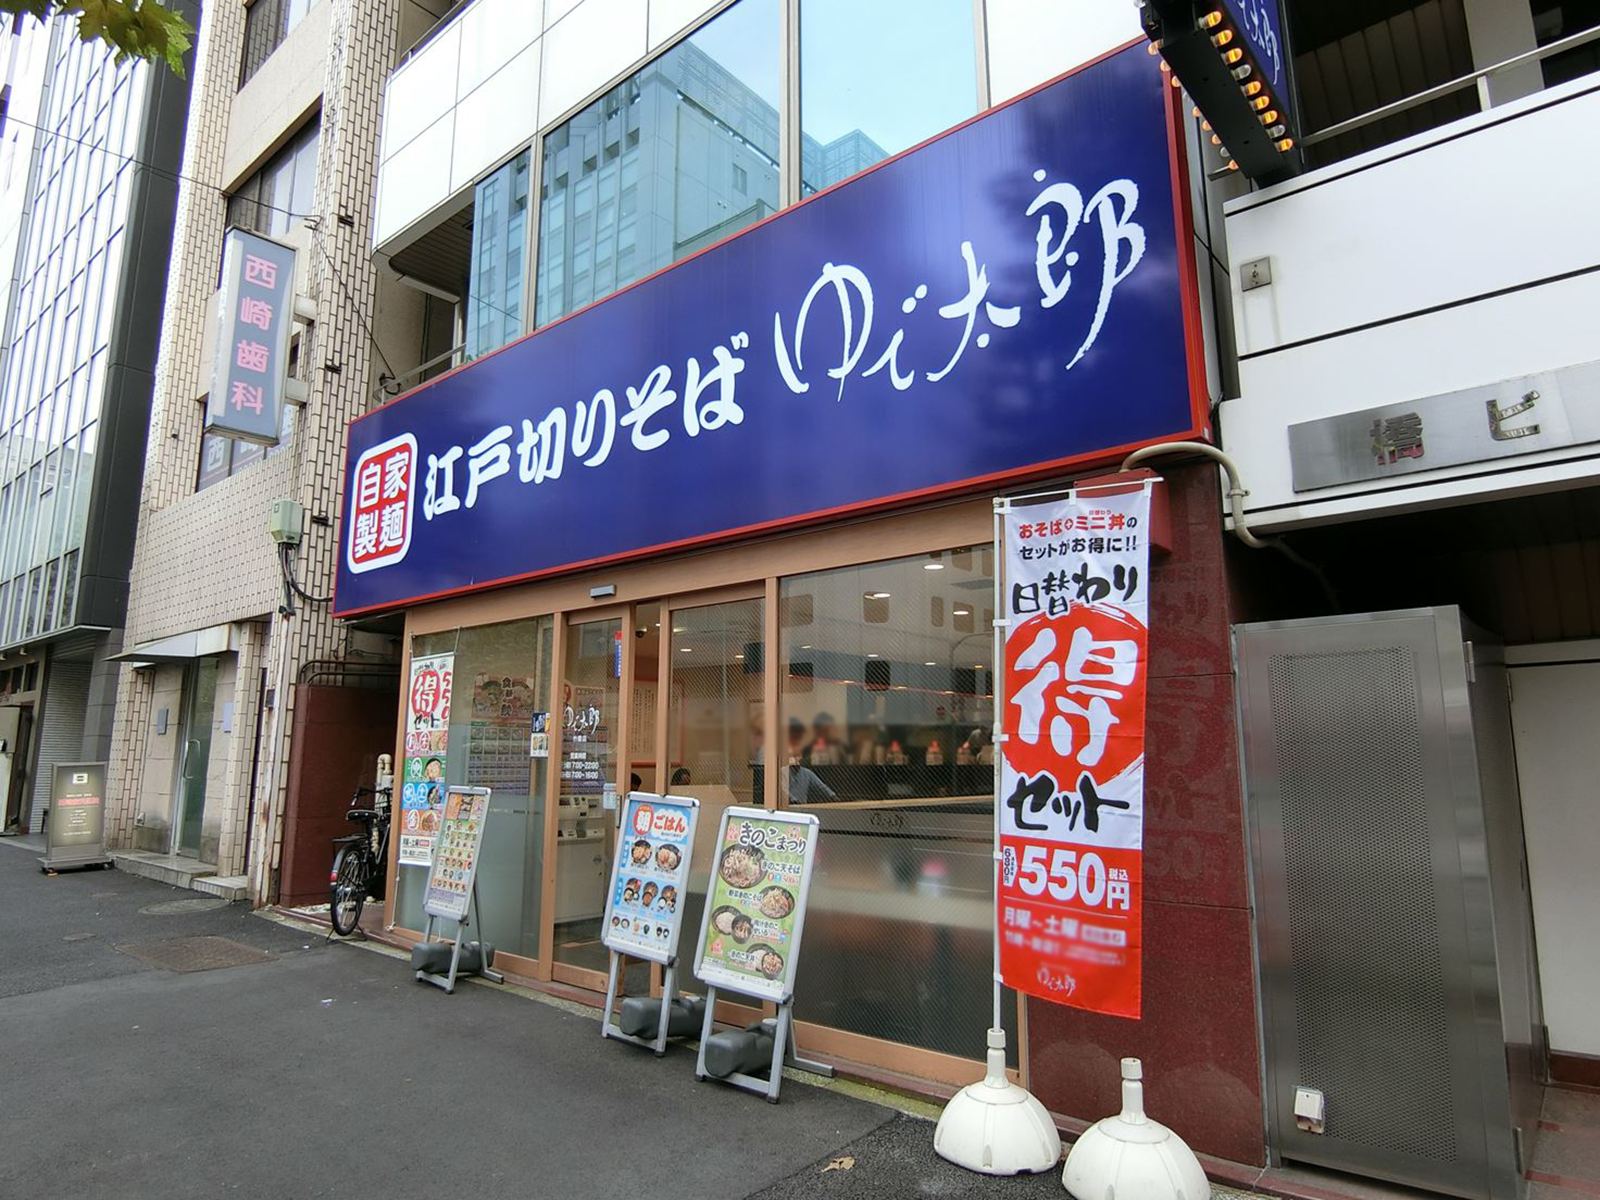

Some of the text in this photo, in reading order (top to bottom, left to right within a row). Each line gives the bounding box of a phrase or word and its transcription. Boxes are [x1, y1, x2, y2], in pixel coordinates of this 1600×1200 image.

[231, 253, 278, 416] 西崎歯科
[774, 169, 1146, 402] ゆで太郎
[422, 331, 750, 521] 江戸切りそば
[1012, 562, 1139, 617] 日替わり
[414, 675, 438, 714] 得
[1010, 626, 1139, 767] 得
[739, 821, 807, 854] きのこまつり
[1006, 773, 1131, 834] セット
